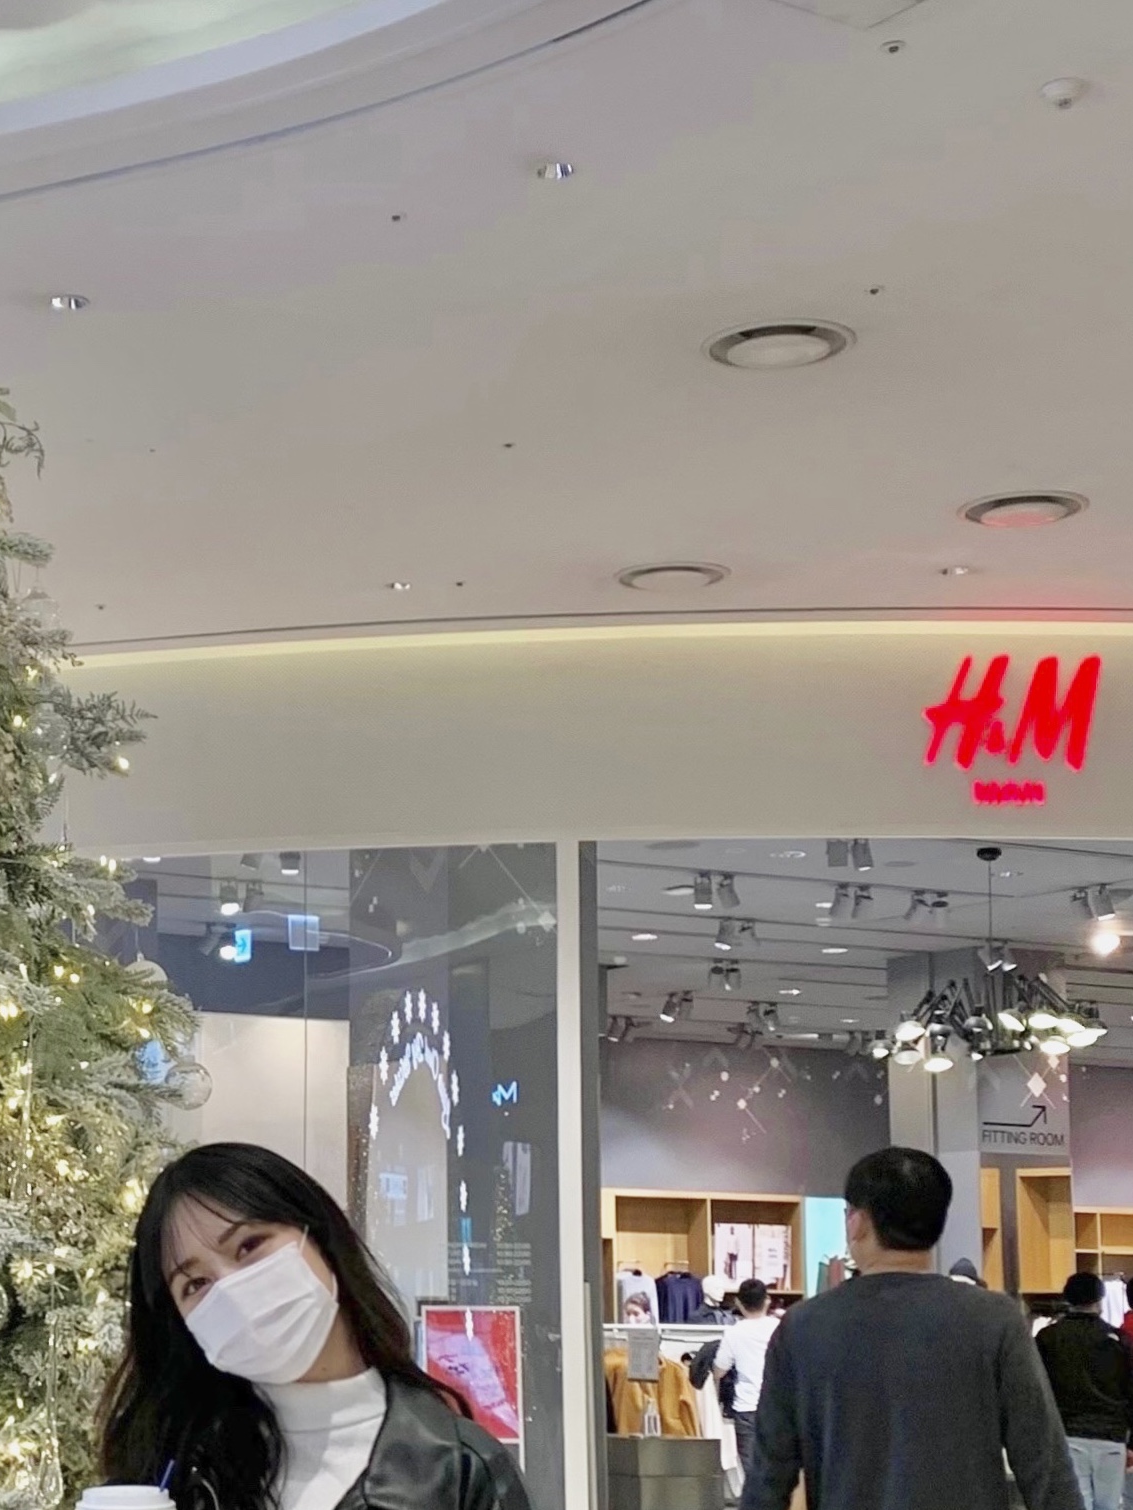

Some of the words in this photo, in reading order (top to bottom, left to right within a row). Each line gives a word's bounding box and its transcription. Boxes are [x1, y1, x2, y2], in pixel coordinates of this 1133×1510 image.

[922, 655, 1101, 771] H&M
[981, 1129, 1027, 1145] FITTING
[1029, 1132, 1064, 1146] ROOM
